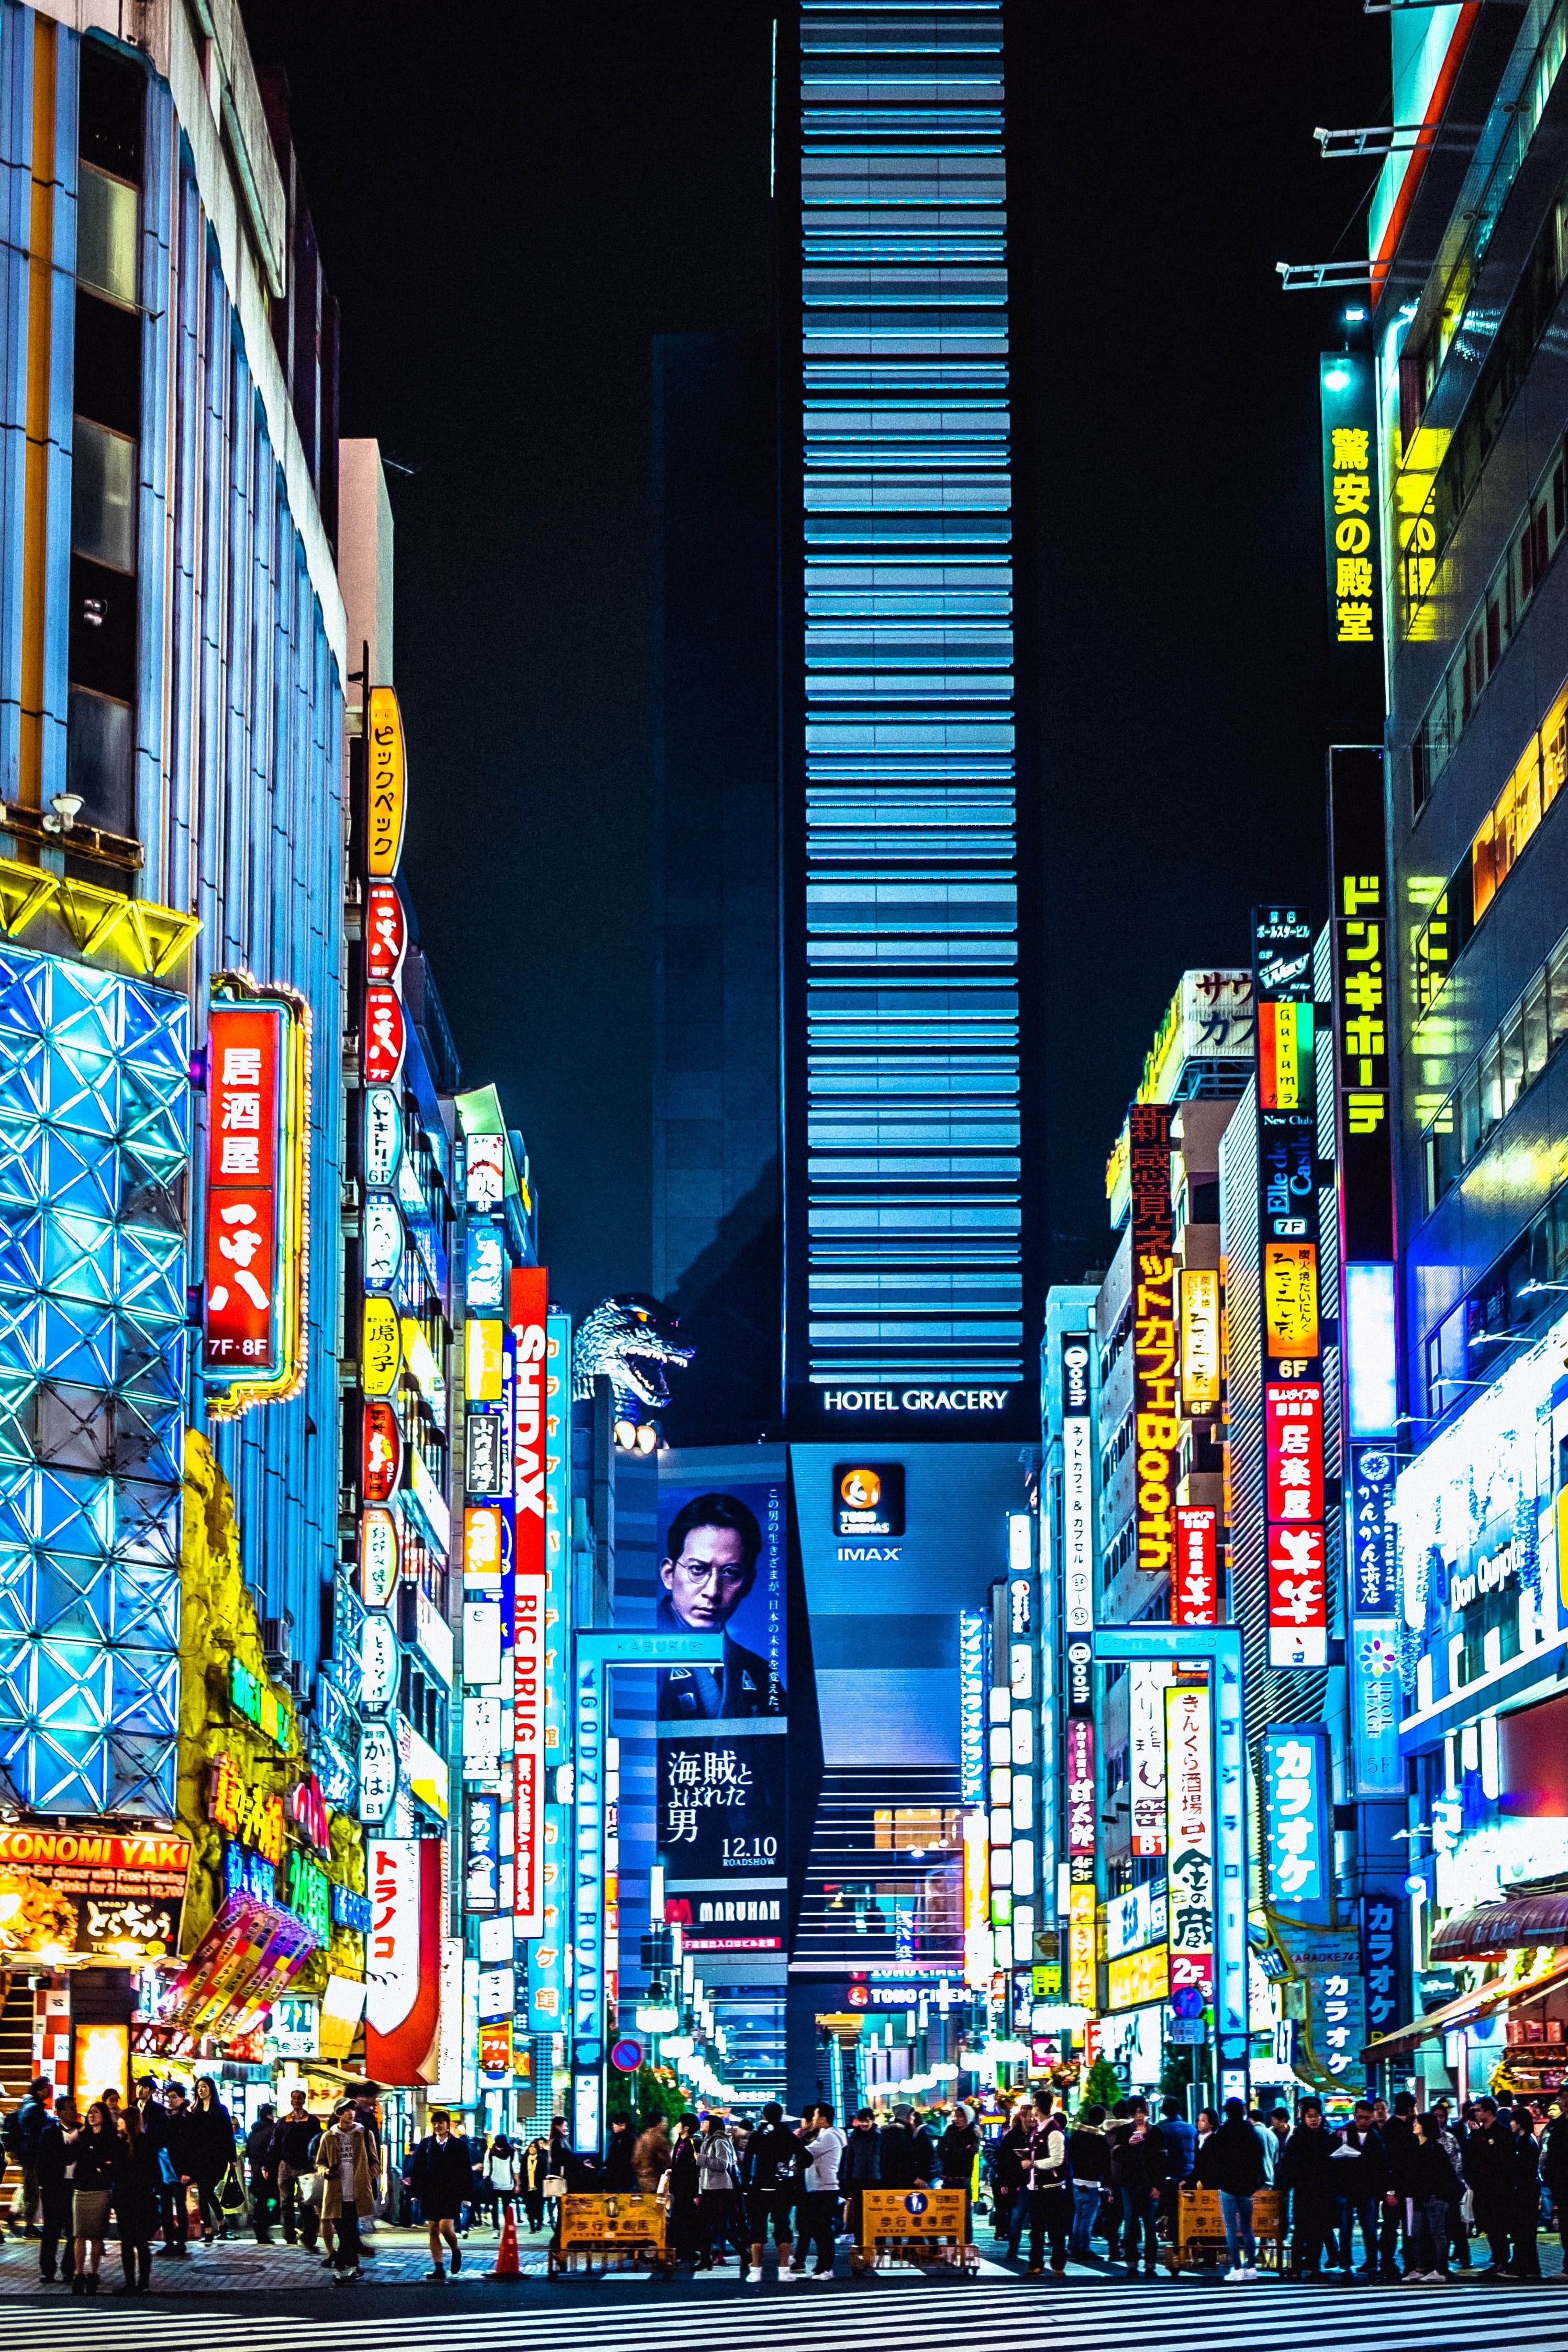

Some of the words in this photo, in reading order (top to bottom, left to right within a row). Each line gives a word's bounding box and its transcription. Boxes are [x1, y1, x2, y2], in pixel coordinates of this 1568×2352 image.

[1331, 428, 1373, 642] 驚安の殿堂
[375, 726, 394, 856] ピックペック
[1197, 972, 1252, 1006] サウ
[1343, 876, 1384, 1133] ドン・キホーテ
[370, 1070, 389, 1079] 7F
[220, 1048, 261, 1174] 居酒屋
[1264, 1116, 1286, 1125] New
[1289, 1115, 1313, 1125] Club
[369, 1170, 391, 1182] 6F
[1267, 1173, 1289, 1215] Elle
[1277, 1222, 1303, 1233] 7F
[207, 1203, 270, 1312] つぼ八
[371, 1278, 386, 1287] 5F
[1279, 1360, 1308, 1378] 6F
[824, 1391, 899, 1410] HOTEL
[902, 1390, 1008, 1410] GRACERY
[1191, 1402, 1213, 1415] 6F
[511, 1324, 546, 1518] SHIDAX
[1280, 1425, 1312, 1518] 居楽屋
[841, 1523, 889, 1534] CINEMAS
[1358, 1484, 1381, 1604] かんかん商店
[838, 1548, 900, 1561] IMAX
[1451, 1573, 1475, 1614] Don
[515, 1595, 537, 1644] BIC
[366, 1703, 383, 1712] 1F
[515, 1656, 536, 1741] DRUG
[1366, 1681, 1381, 1739] STAGE
[1380, 1681, 1393, 1727] IDOL
[668, 1750, 753, 1787] 海賊と
[1182, 1694, 1204, 1815] きんくら酒場
[1367, 1757, 1393, 1774] 5F
[578, 1695, 599, 1890] GODZILLA
[668, 1786, 746, 1807] よばれた
[666, 1809, 698, 1843] 男
[1276, 1740, 1316, 1893] カラオケ
[121, 1839, 190, 1868] YAKI
[722, 1836, 777, 1858] 12.10
[722, 1858, 775, 1867] ROADSHOW
[1139, 1836, 1166, 1855] B1
[54, 1866, 91, 1879] dinner
[91, 1867, 116, 1880] with
[117, 1870, 186, 1886] Free-Flowing
[1072, 1857, 1093, 1869] 4F
[1072, 1869, 1093, 1881] 3F
[52, 1879, 87, 1893] Drinks
[90, 1881, 106, 1894] for
[107, 1882, 116, 1894] 2
[116, 1882, 148, 1895] hours
[1173, 1848, 1213, 1949] 金の蔵
[374, 1851, 397, 1959] トラノコ
[699, 1901, 781, 1922] MARUHAN
[578, 1913, 598, 2002] ROAD
[1173, 1957, 1205, 1984] 2F
[1368, 1903, 1396, 2025] カラオケ
[1324, 1975, 1353, 2074] カラオケ
